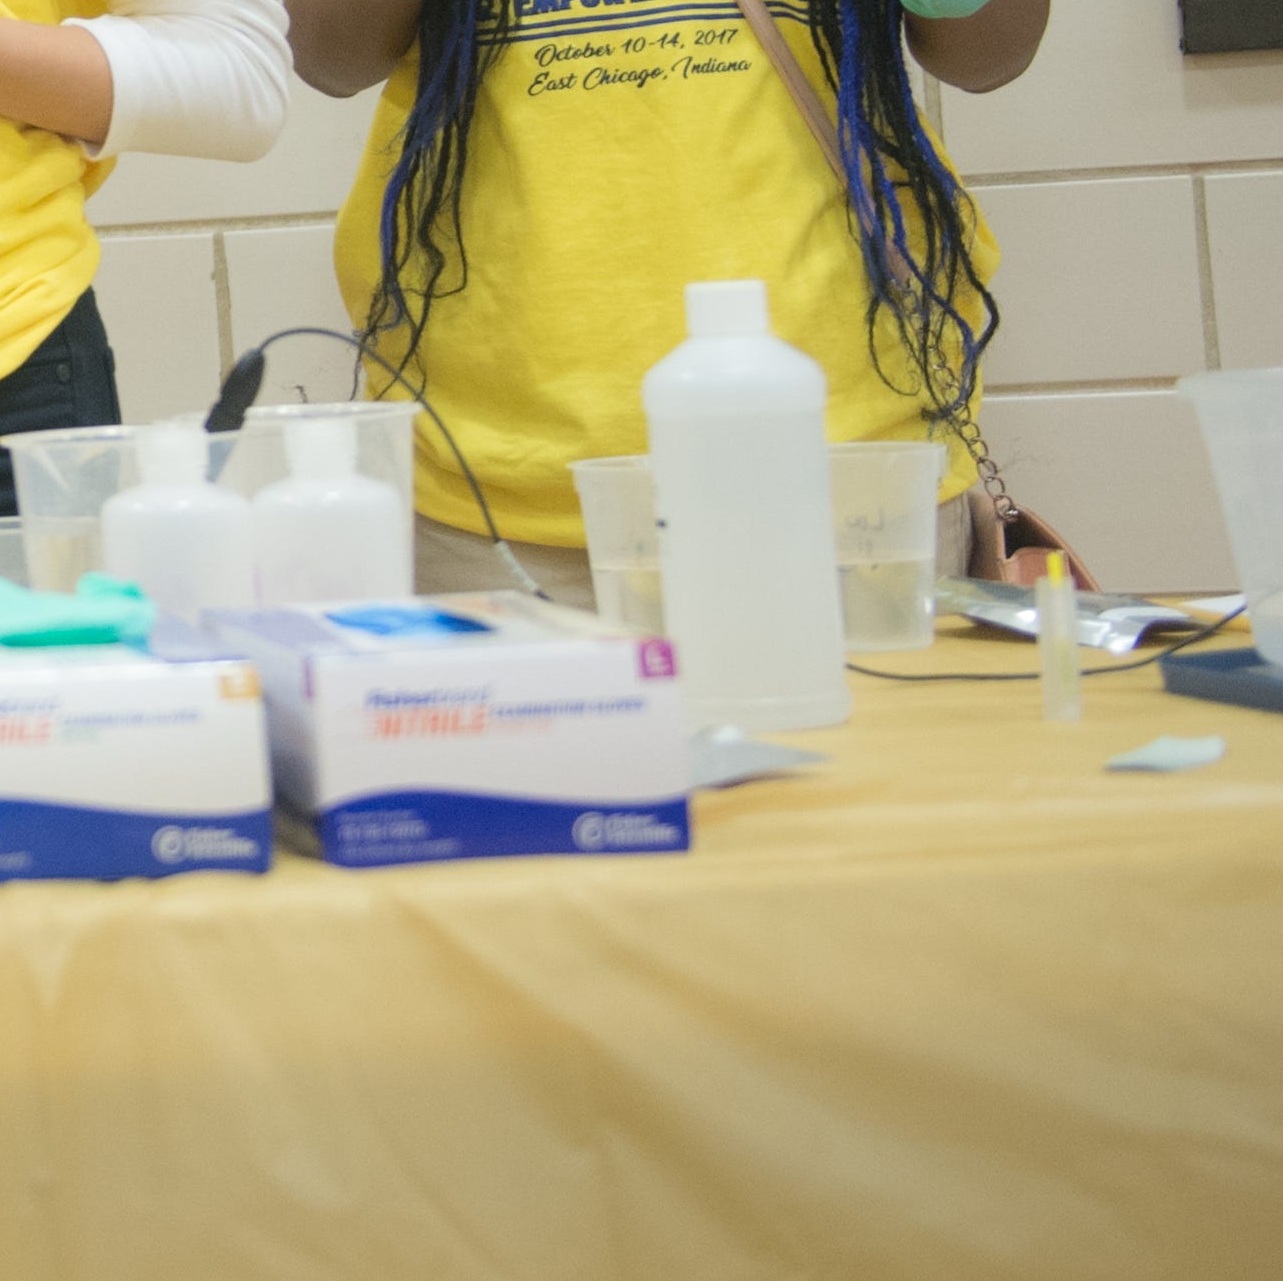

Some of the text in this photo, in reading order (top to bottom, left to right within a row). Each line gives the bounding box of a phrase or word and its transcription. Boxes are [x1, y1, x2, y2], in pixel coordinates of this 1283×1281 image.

[534, 28, 739, 69] October 10-14, 2017
[527, 55, 753, 97] East Chicago, Indiana
